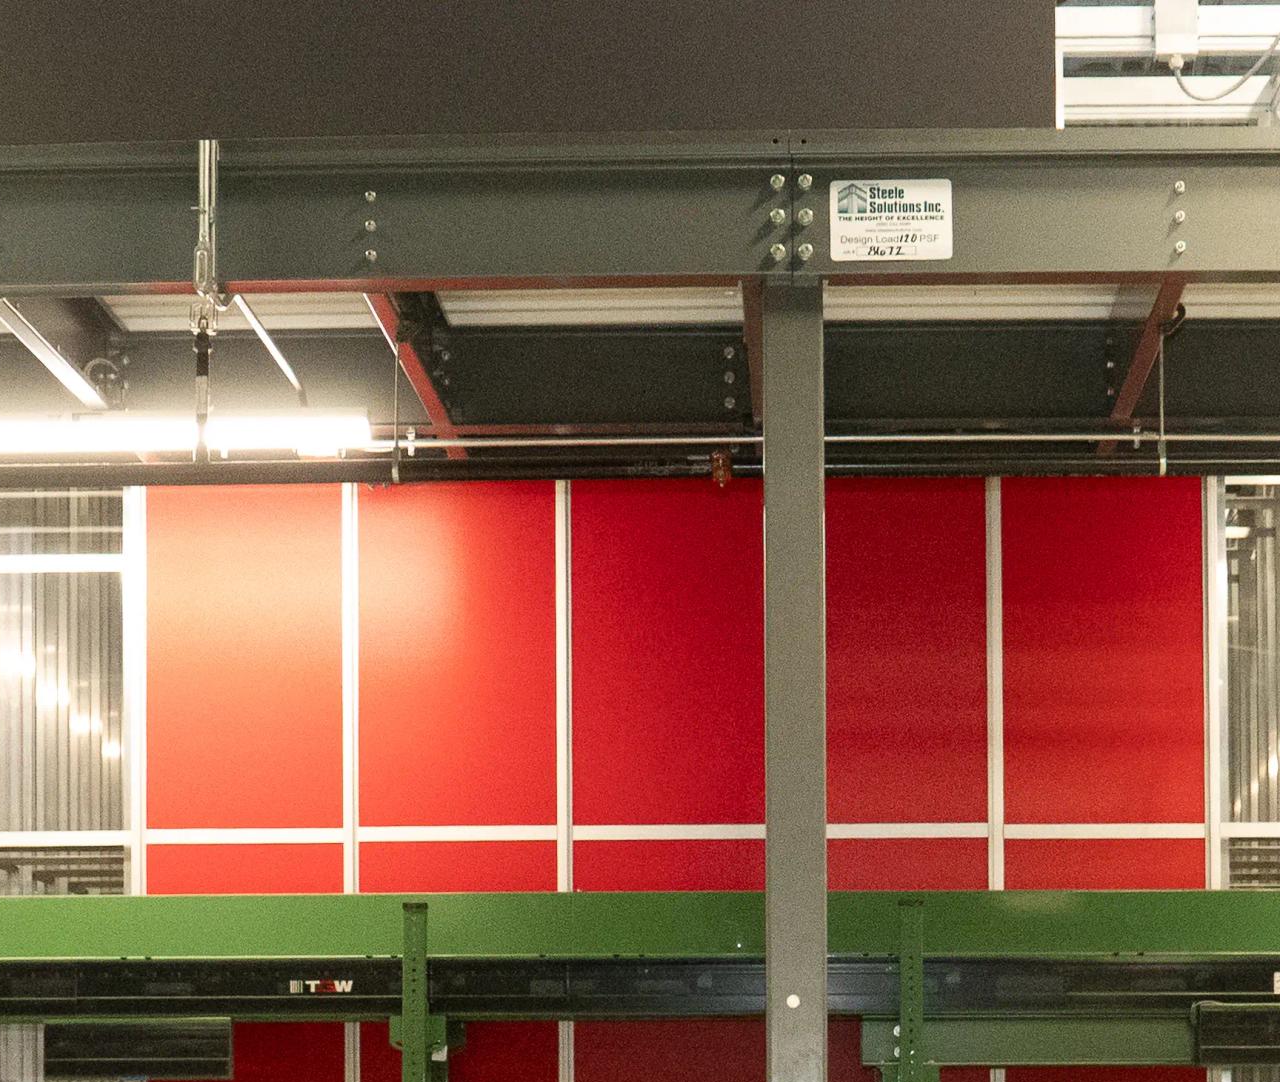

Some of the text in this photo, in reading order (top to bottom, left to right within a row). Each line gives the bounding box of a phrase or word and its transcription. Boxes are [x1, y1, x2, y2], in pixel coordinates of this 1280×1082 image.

[869, 187, 905, 199] Steele
[869, 200, 945, 214] Solutions Inc.
[840, 235, 873, 245] Design
[876, 234, 900, 244] Load
[920, 234, 940, 243] PSF
